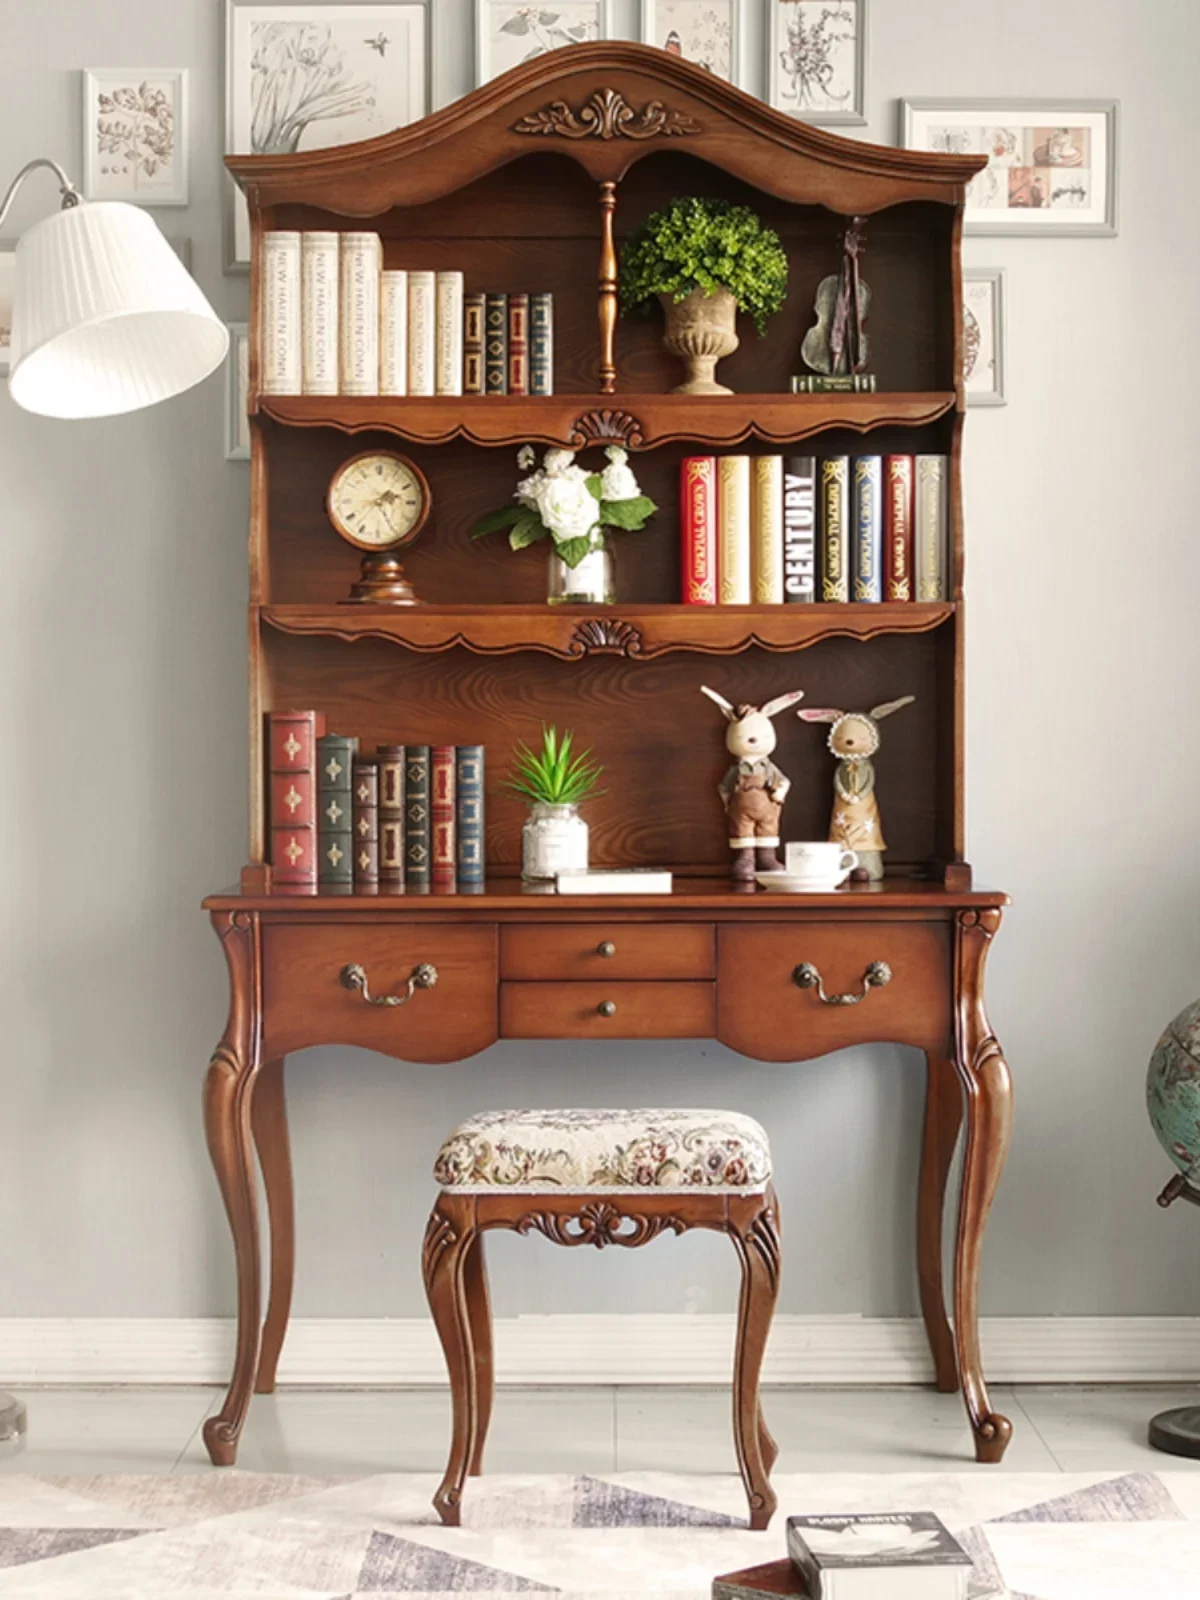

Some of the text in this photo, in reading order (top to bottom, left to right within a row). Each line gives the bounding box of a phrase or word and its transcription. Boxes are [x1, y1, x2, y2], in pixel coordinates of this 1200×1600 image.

[277, 252, 287, 282] NEW
[316, 253, 326, 284] NEW
[355, 252, 364, 284] NEW
[316, 340, 326, 378] CONN
[355, 339, 364, 378] CONN
[693, 483, 706, 525] CROWN
[785, 473, 814, 594] CENTURY
[827, 537, 840, 578] CROWN
